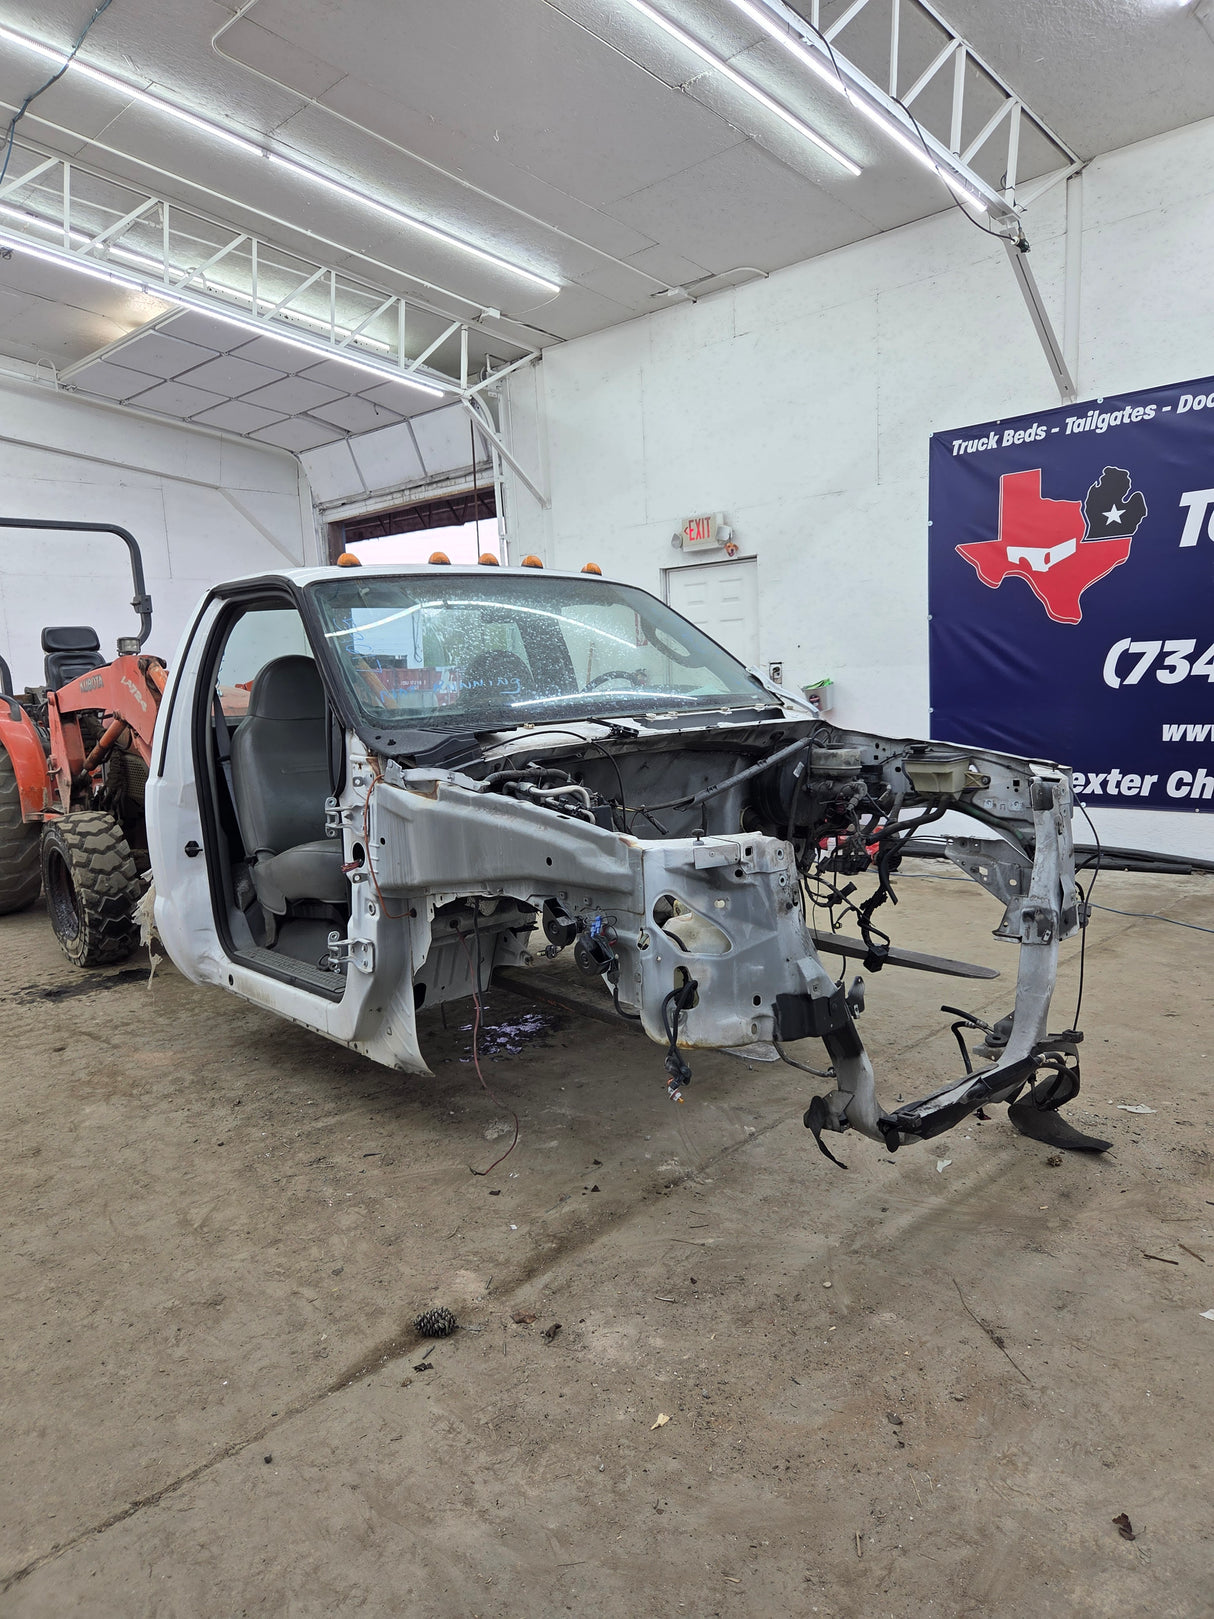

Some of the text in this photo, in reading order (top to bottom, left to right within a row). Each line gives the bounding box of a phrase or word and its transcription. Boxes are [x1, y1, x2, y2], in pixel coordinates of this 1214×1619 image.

[952, 431, 999, 456] Truck
[1002, 422, 1047, 447] Beds
[1065, 404, 1157, 435] Tailgates
[688, 516, 711, 541] EXIT
[1179, 488, 1214, 547] T
[1103, 637, 1214, 689] (734
[80, 674, 104, 693] KUBOTA
[1162, 724, 1214, 742] ww
